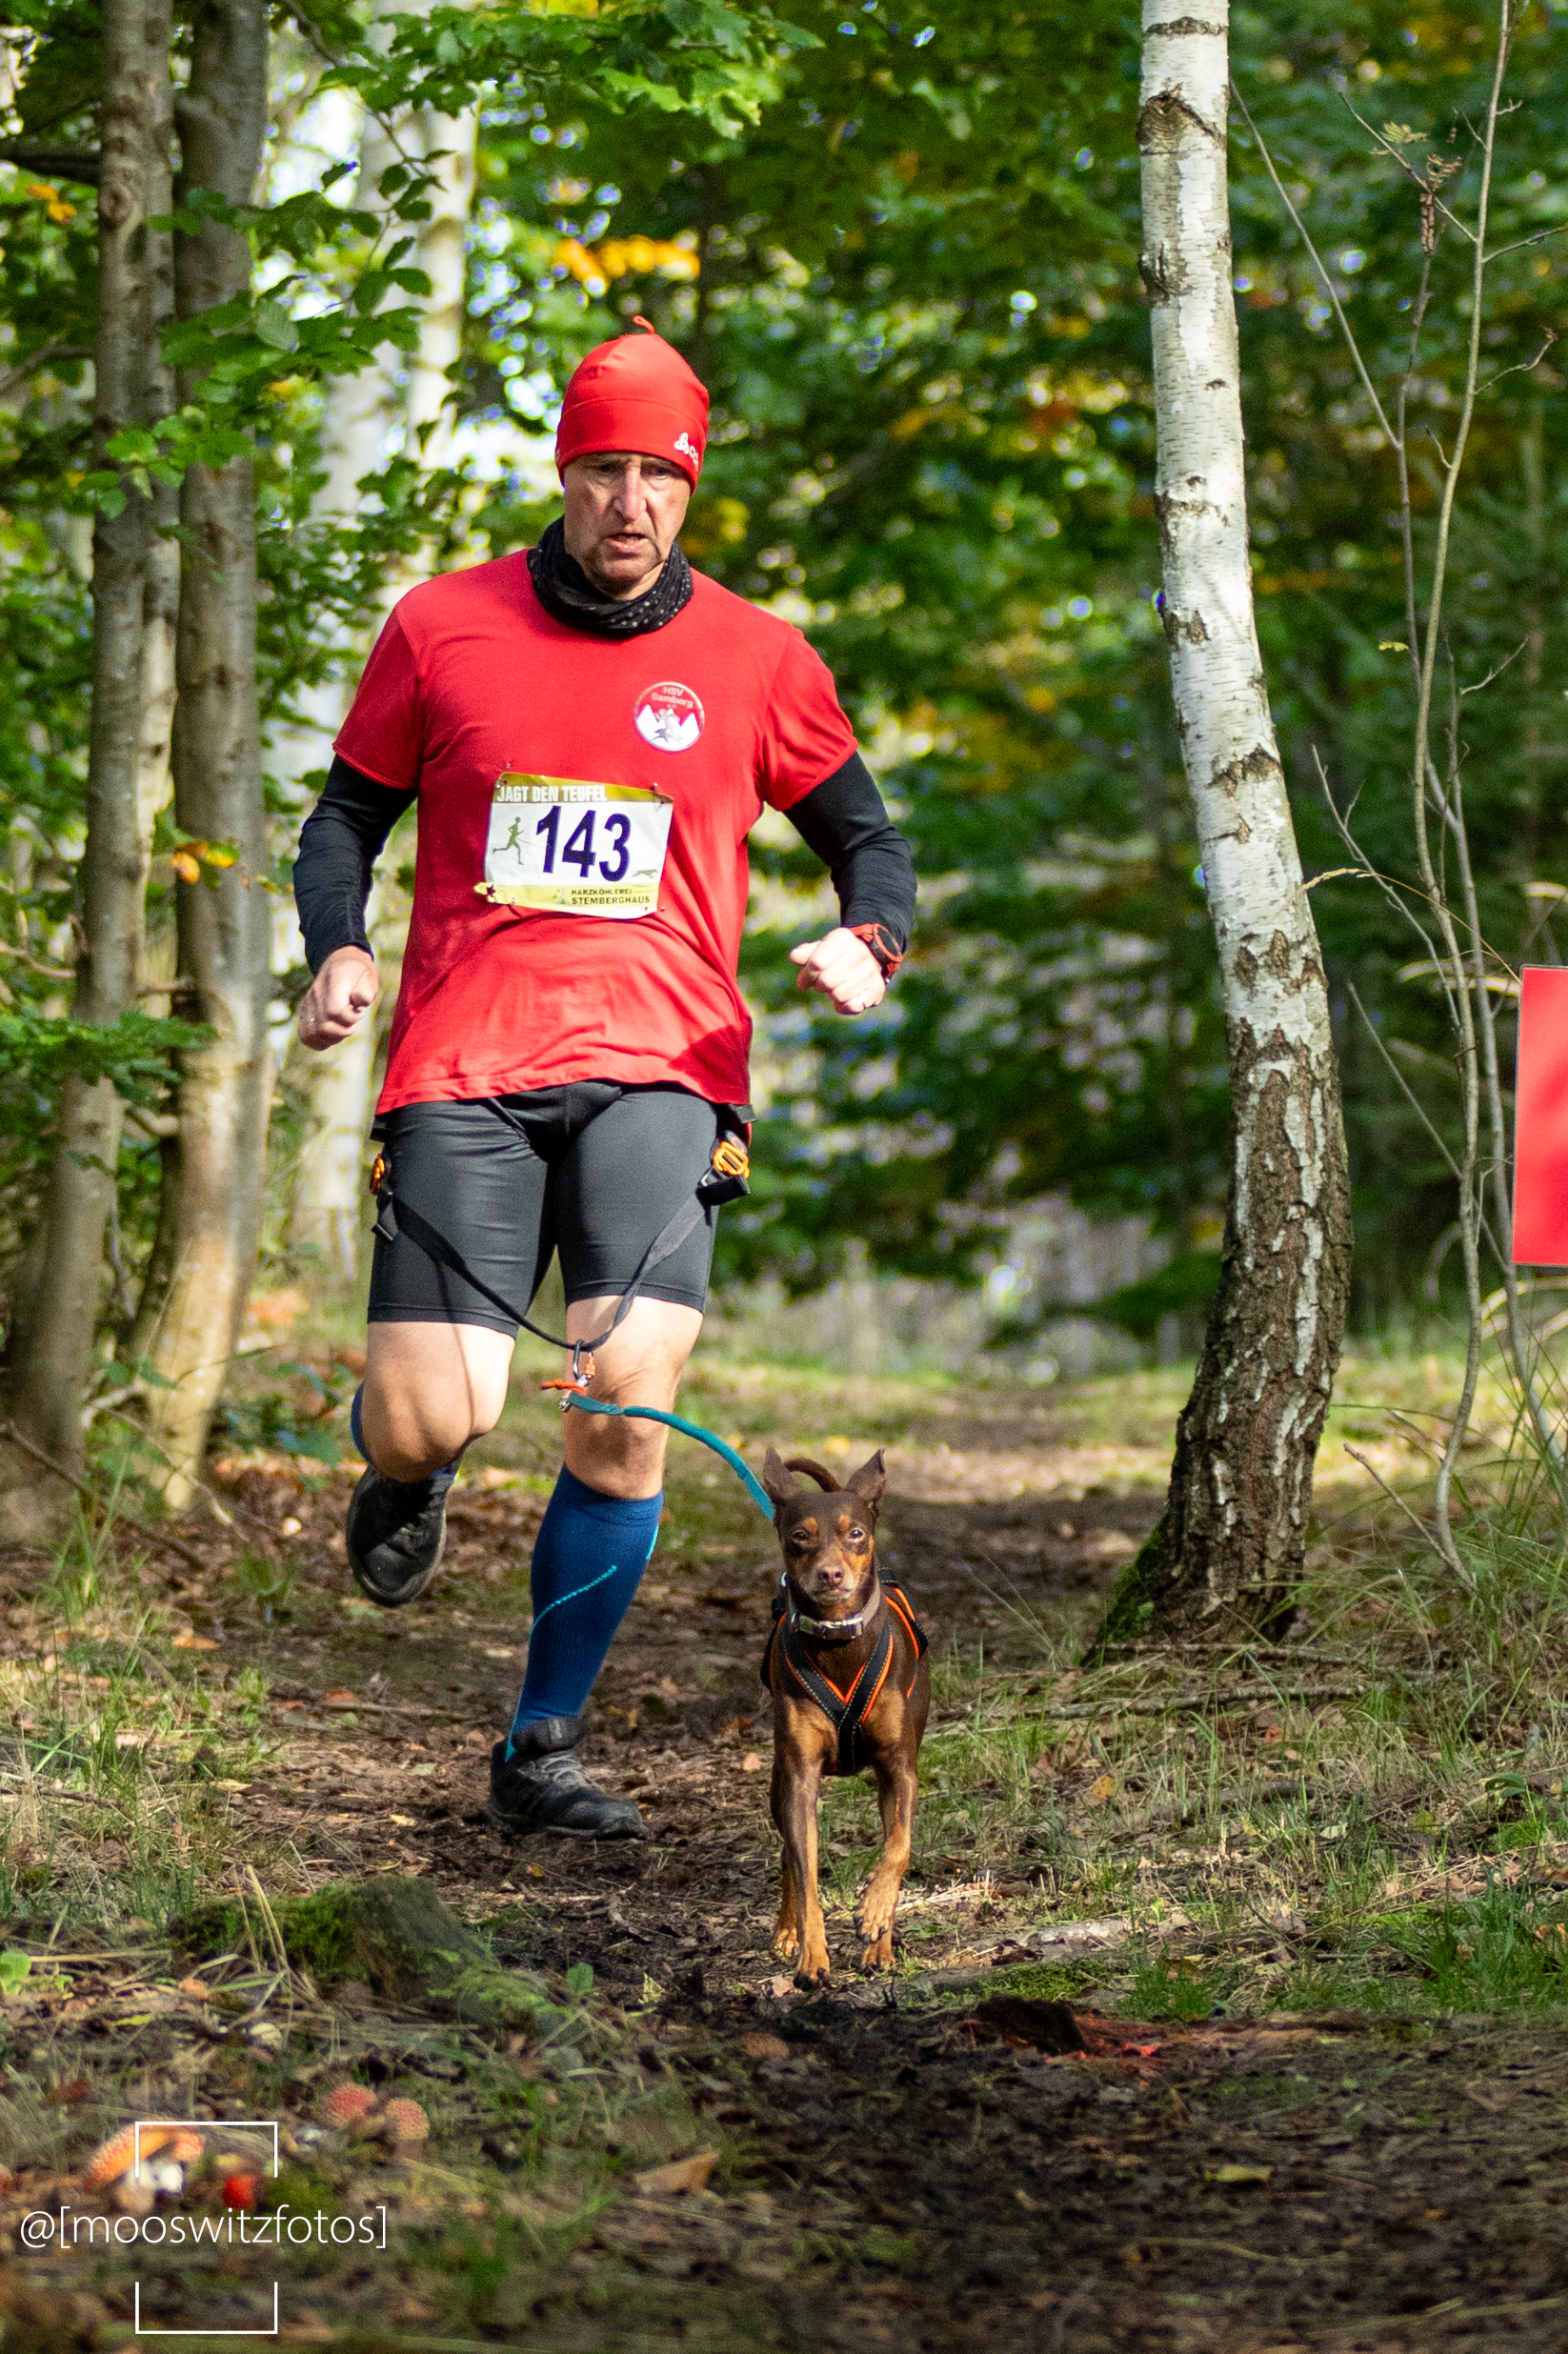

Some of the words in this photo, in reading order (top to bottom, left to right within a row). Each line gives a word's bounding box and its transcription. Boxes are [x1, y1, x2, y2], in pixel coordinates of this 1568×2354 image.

[663, 686, 684, 696] HSV
[497, 786, 529, 802] JAGT
[533, 786, 558, 802] DEN
[561, 785, 608, 802] TEUFEL
[535, 805, 631, 882] 143
[572, 896, 651, 906] STEMBERGHAUS
